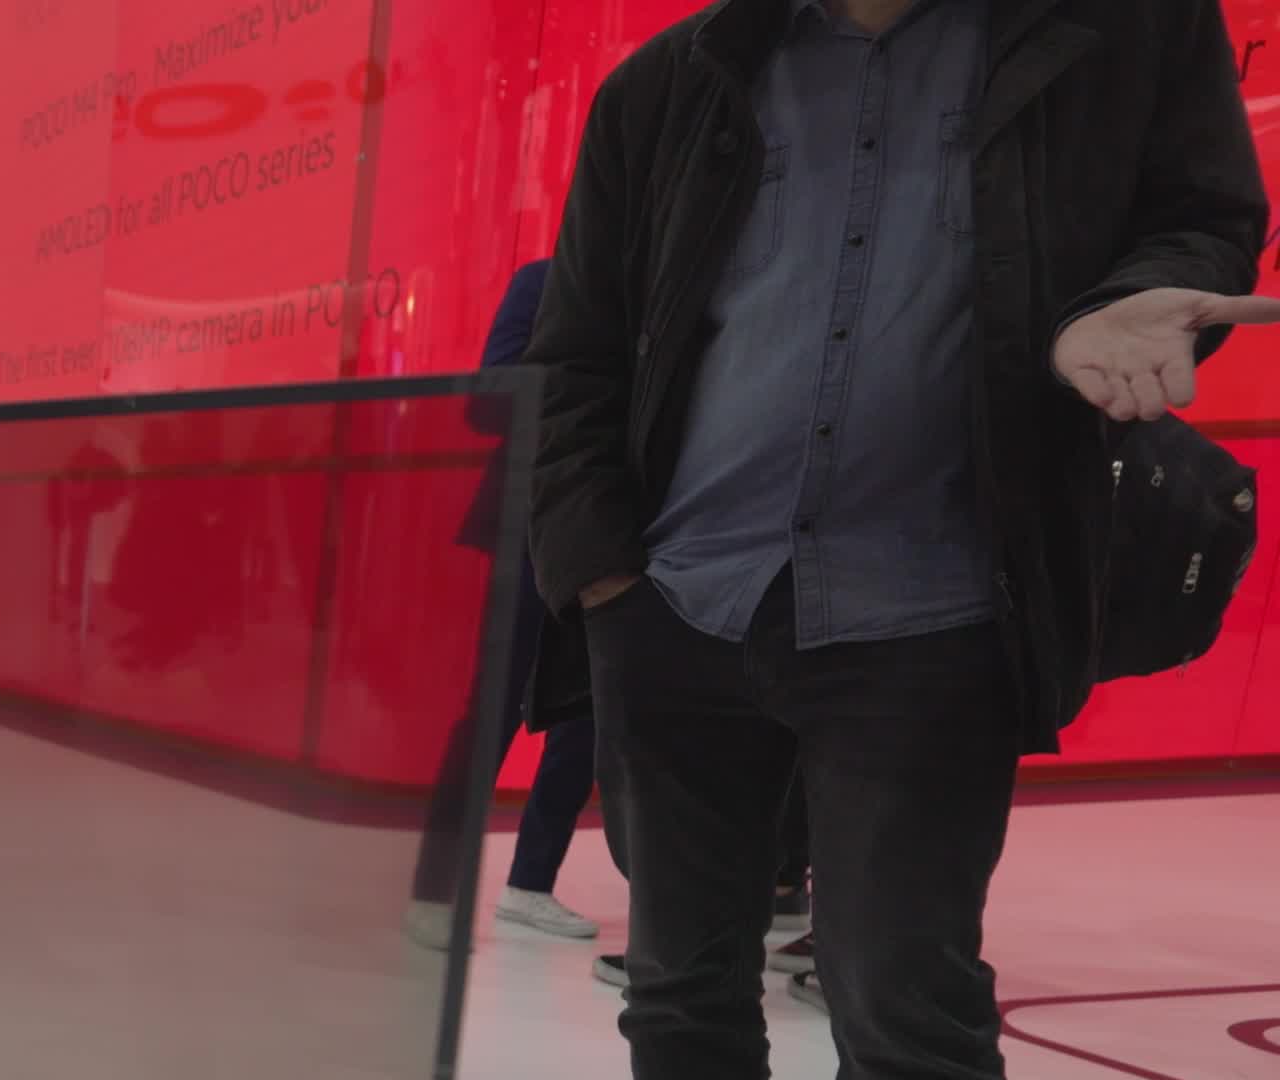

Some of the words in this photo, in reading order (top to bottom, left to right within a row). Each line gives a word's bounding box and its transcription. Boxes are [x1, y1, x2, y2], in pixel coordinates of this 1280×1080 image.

[152, 3, 264, 88] Maximize
[271, 0, 328, 47] you
[116, 194, 145, 239] for
[148, 174, 175, 226] all
[178, 150, 251, 218] POCO
[255, 127, 337, 192] series
[175, 305, 264, 354] camera
[272, 288, 296, 337] in
[305, 267, 401, 332] POO
